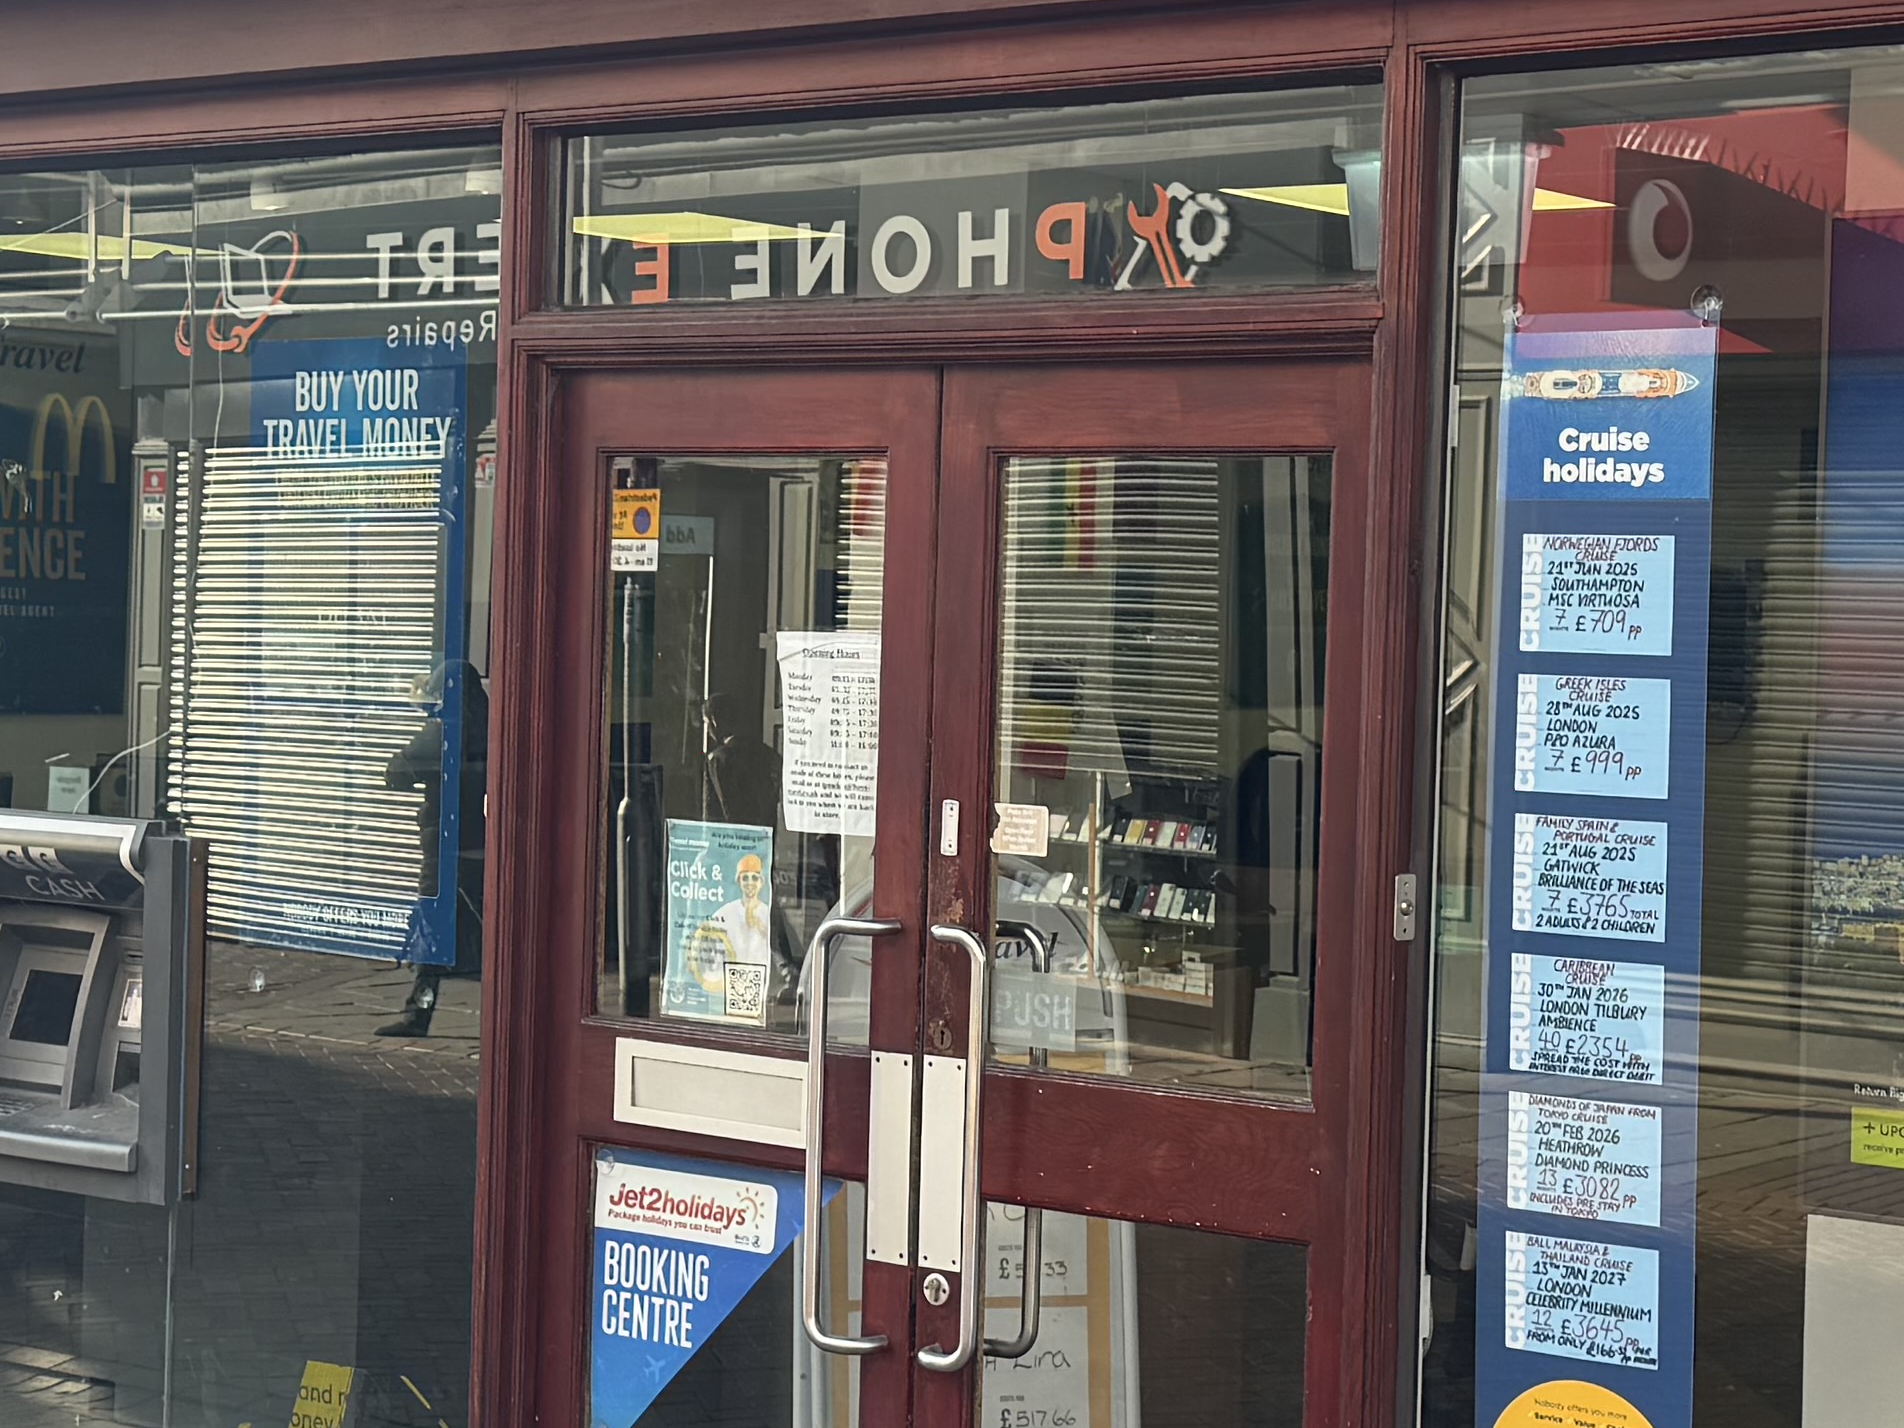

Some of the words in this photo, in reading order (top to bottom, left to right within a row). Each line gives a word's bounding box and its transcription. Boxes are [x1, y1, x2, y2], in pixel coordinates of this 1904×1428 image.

[296, 371, 344, 412] BUY
[353, 369, 419, 411] YOUR
[263, 419, 351, 459] TRAVEL
[362, 417, 452, 458] MONEY
[1559, 427, 1650, 452] Cruise
[1543, 457, 1665, 487] holidays
[1543, 537, 1612, 551] NORWEGIAN
[1614, 537, 1660, 552] FJORDS
[1574, 562, 1601, 576] JUN
[1551, 576, 1644, 593] SOUTHAMPTON
[1548, 593, 1573, 607] MSC
[1578, 593, 1640, 609] VIRTUOSA
[1556, 677, 1593, 691] GREEK
[1596, 678, 1627, 691] ISLES
[1547, 718, 1597, 734] LONDON
[1572, 735, 1616, 750] AZURA
[671, 860, 706, 881] Click
[712, 864, 722, 881] &
[1544, 860, 1601, 876] GATWICK
[25, 875, 105, 901] CASH
[671, 882, 724, 902] Collect
[1554, 959, 1615, 976] CARIBBEAN
[1540, 1000, 1589, 1017] LONDON
[1594, 1003, 1647, 1021] TILBURY
[1538, 1014, 1597, 1033] AMBIENCE
[1538, 1137, 1604, 1158] HEATHROW
[1535, 1153, 1589, 1172] DIAMOND
[608, 1208, 641, 1222] Package
[674, 1220, 688, 1230] you
[1540, 1251, 1591, 1267] THAILAND
[603, 1239, 710, 1301] BOOKING
[1526, 1291, 1579, 1311] CELEBRITY
[1579, 1301, 1652, 1322] MILLENNIUM
[601, 1289, 693, 1349] CENTRE
[299, 1384, 332, 1405] and
